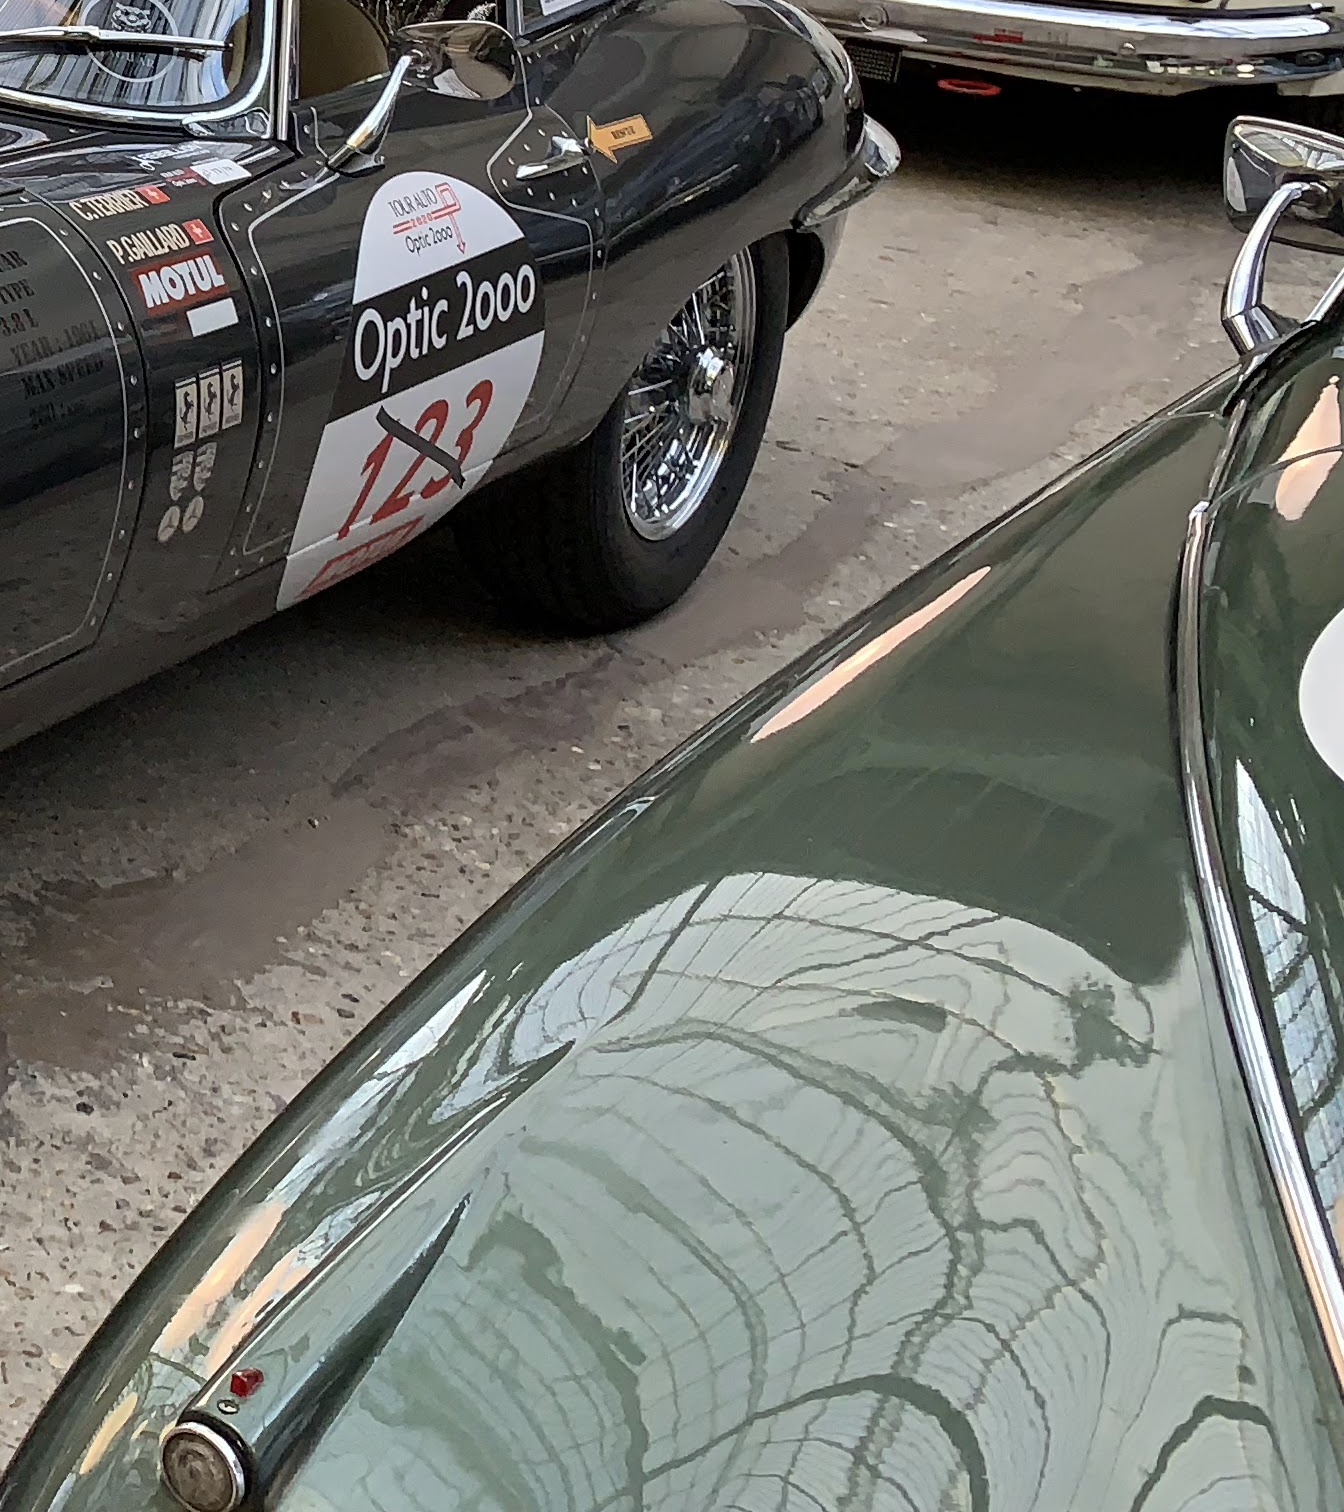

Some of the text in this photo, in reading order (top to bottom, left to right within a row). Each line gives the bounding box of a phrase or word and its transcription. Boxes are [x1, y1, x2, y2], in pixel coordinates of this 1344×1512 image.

[68, 188, 150, 222] C.TERRIER
[388, 187, 438, 218] TOUR AUTO
[106, 223, 191, 265] P.GAILLARD
[405, 225, 453, 256] Optic 2000
[138, 254, 225, 309] MOTUL
[354, 263, 537, 394] Optic 2000
[336, 379, 493, 541] 123
